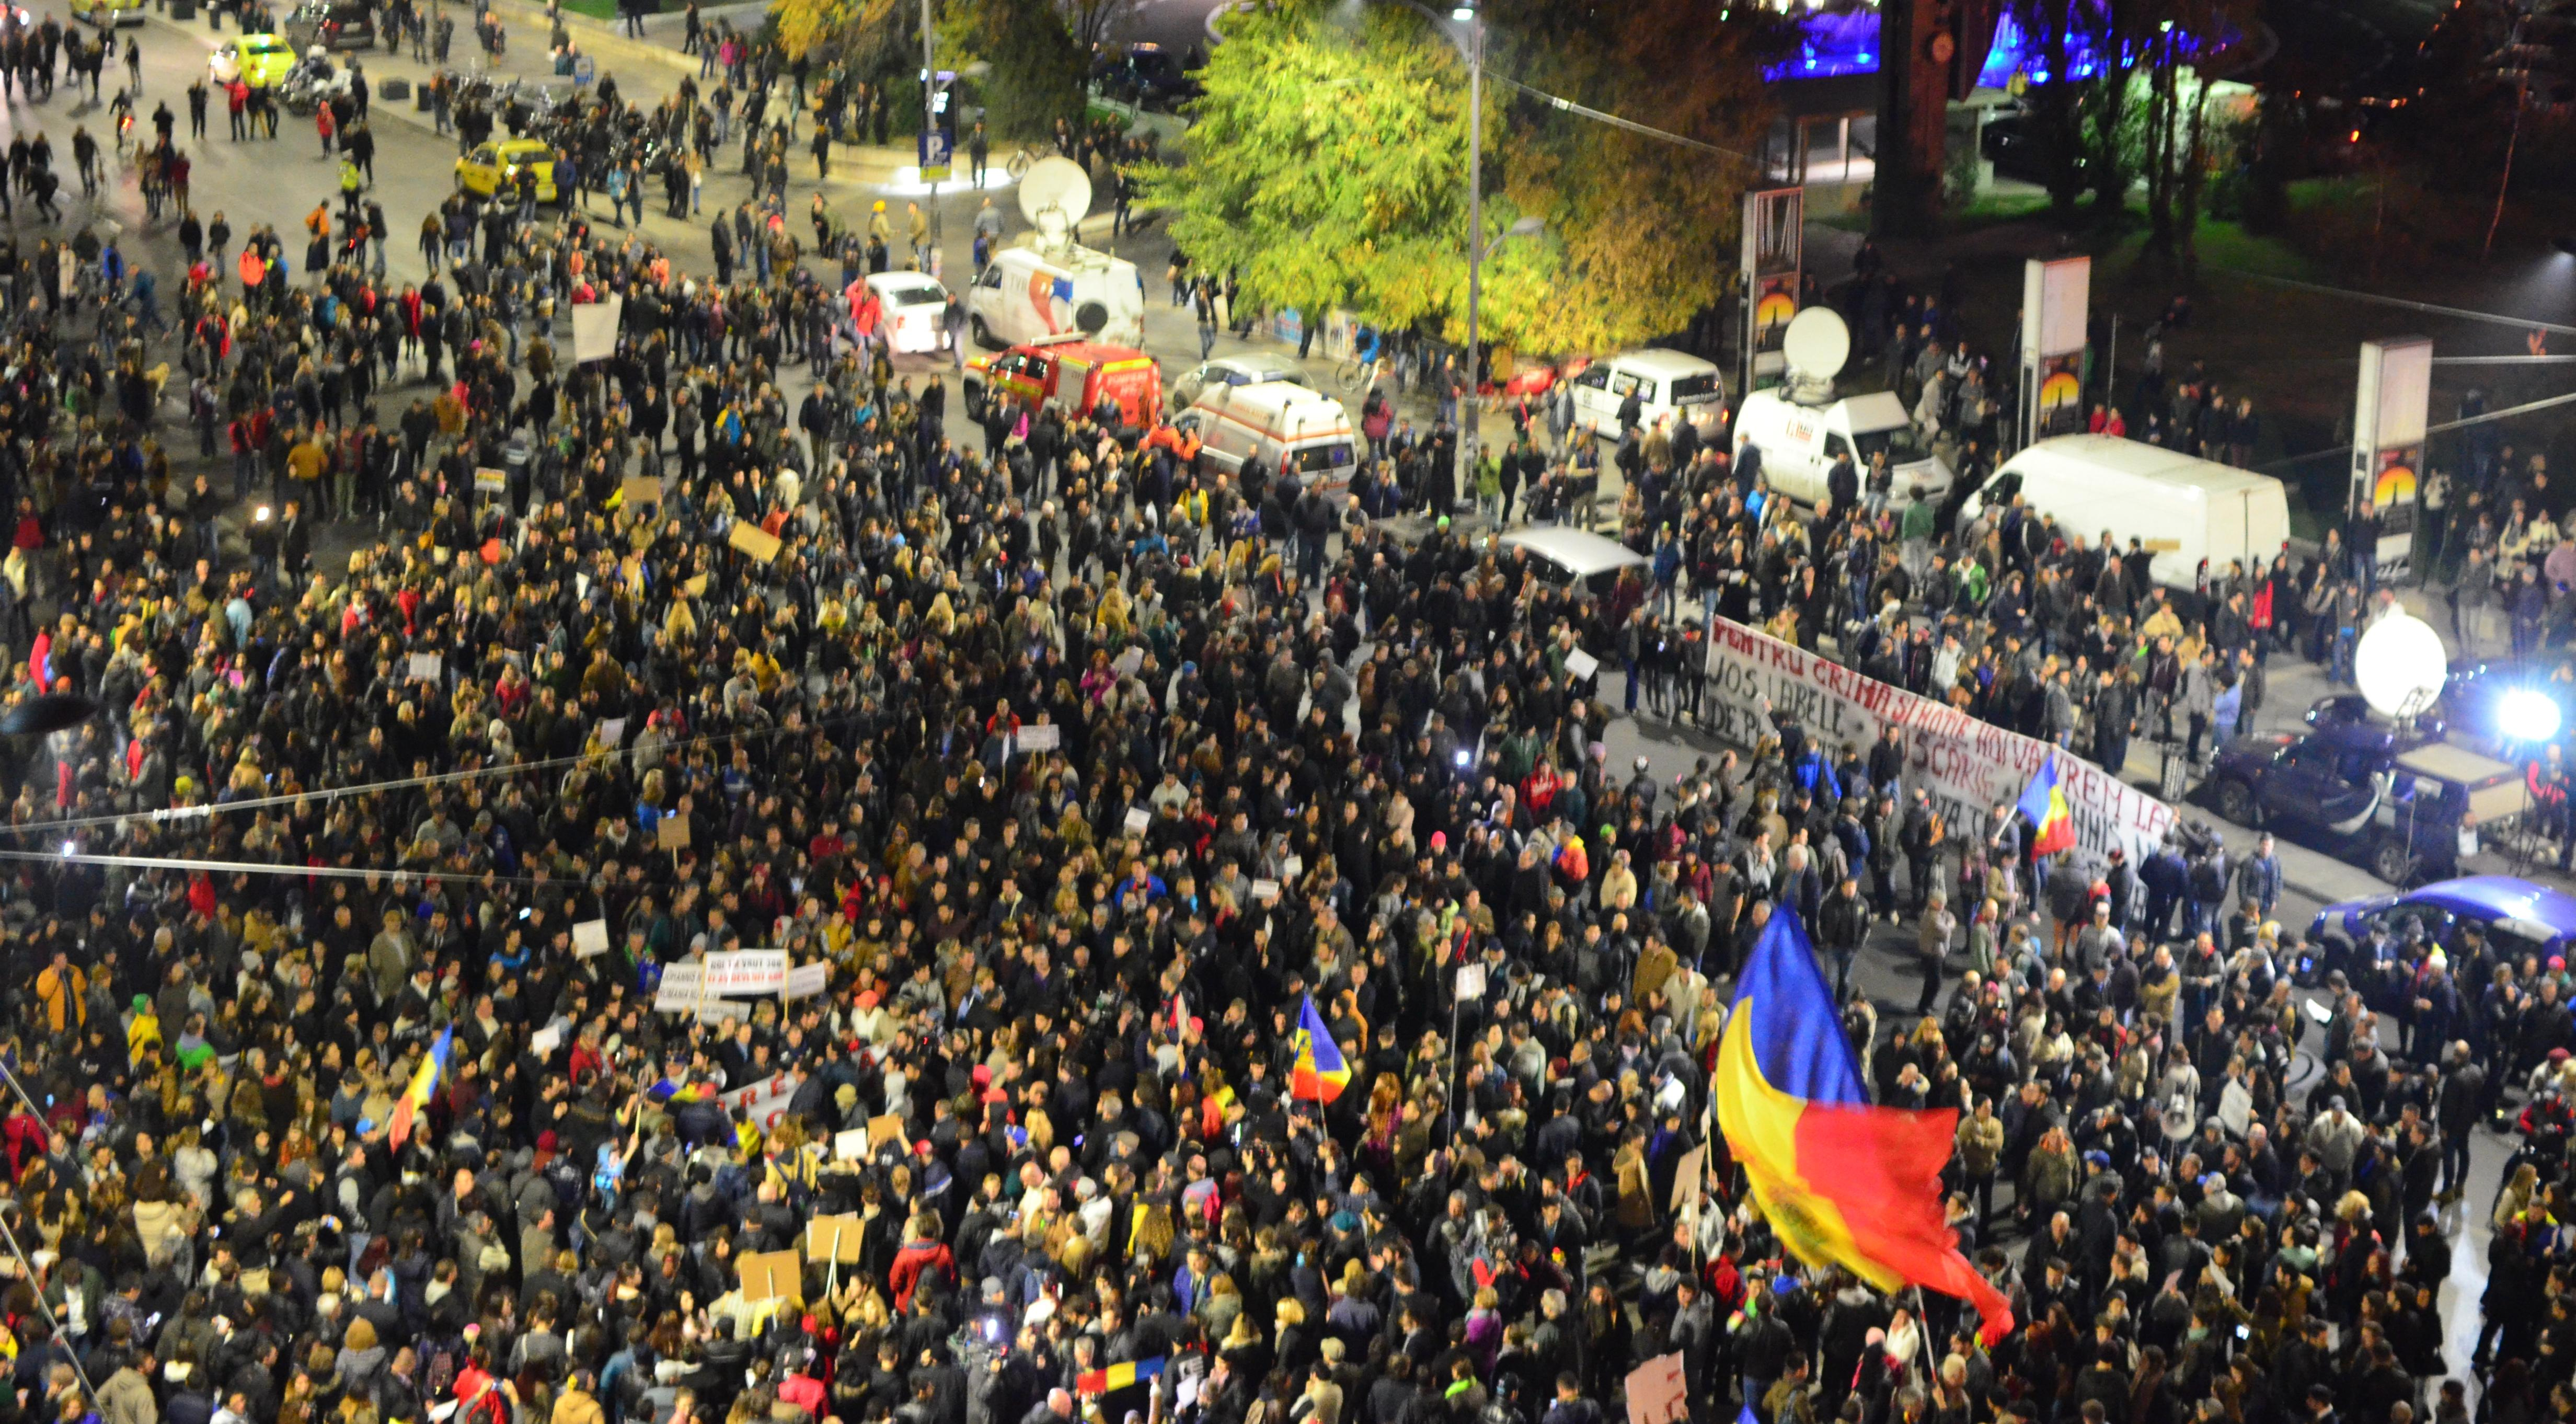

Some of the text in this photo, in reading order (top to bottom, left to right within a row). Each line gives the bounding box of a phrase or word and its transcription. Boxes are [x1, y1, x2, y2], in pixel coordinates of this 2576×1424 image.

[1705, 656, 1758, 699] JOS
[1714, 619, 1804, 677] PENTRU
[1813, 657, 1892, 714] CRIMA
[2133, 794, 2168, 833] LA
